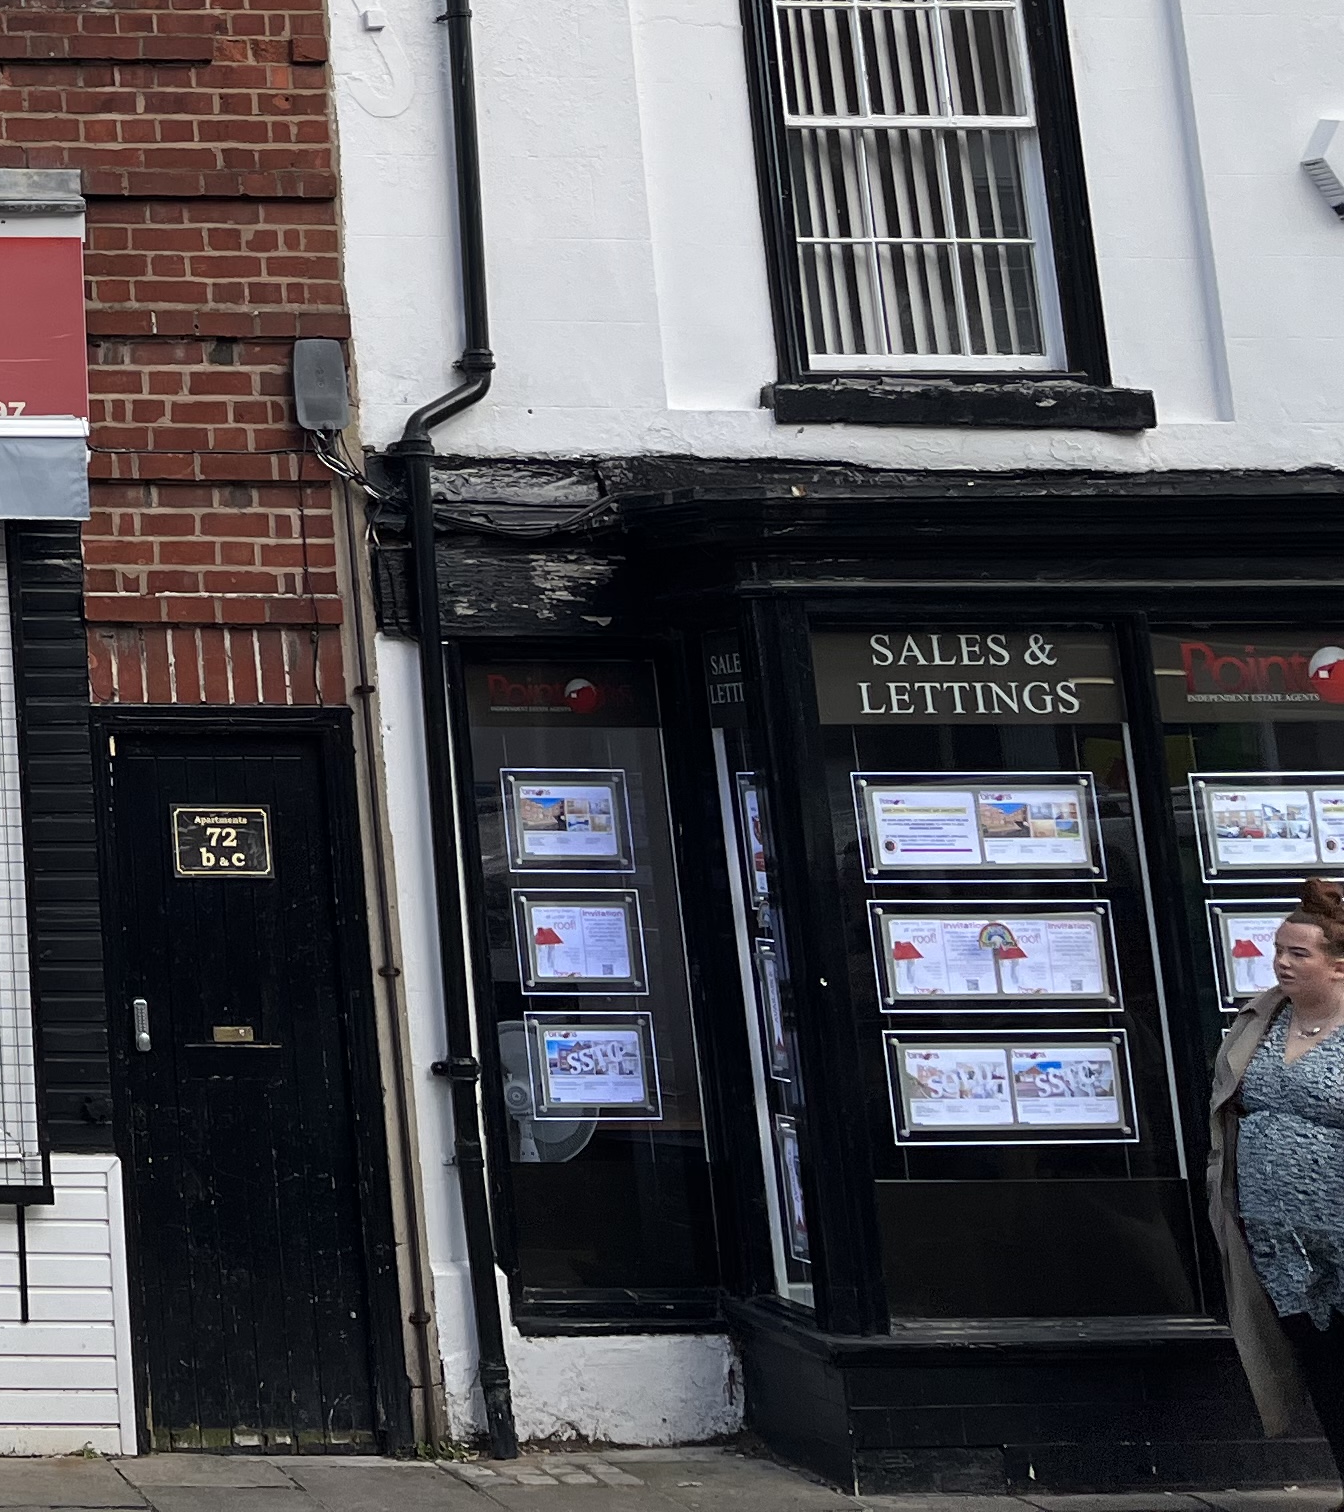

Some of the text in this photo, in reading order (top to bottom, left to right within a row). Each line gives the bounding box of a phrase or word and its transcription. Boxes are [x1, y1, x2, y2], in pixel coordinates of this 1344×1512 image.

[869, 633, 1058, 667] SALES &
[859, 680, 1083, 716] LETTINGS
[194, 815, 248, 826] Apartments
[206, 827, 238, 847] 72
[199, 847, 216, 867] b
[219, 856, 230, 867] &
[582, 909, 623, 918] Invitation
